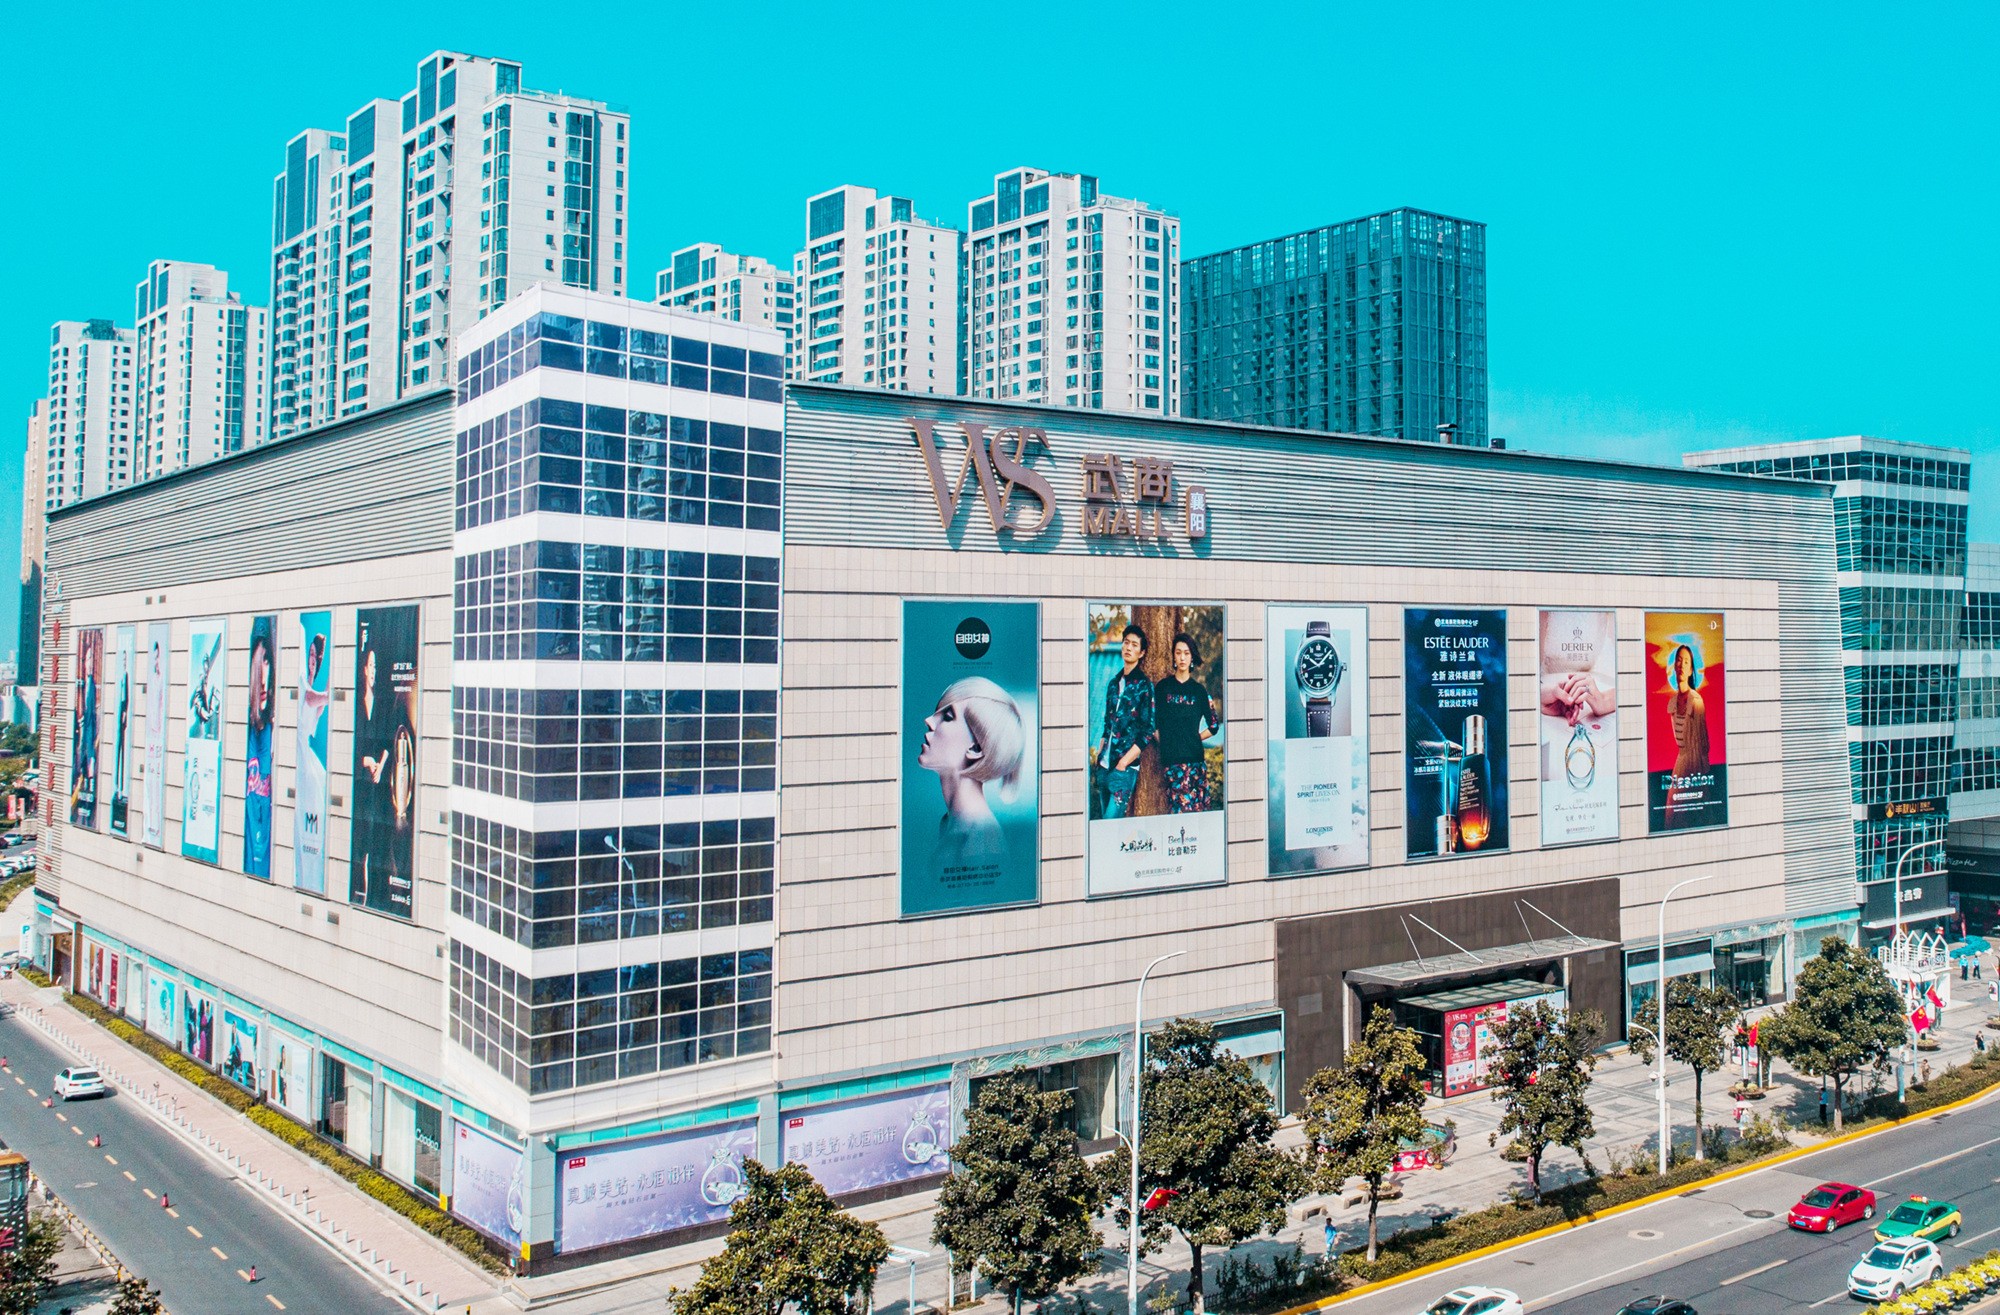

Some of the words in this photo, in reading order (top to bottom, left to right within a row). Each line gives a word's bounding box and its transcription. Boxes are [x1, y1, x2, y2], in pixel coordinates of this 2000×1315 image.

[905, 417, 1056, 532] WS
[1082, 453, 1174, 503] 武商
[1190, 491, 1205, 532] 襄阳
[1081, 505, 1173, 538] MALL
[955, 632, 990, 644] 自由女神
[1453, 637, 1489, 649] LAUDER
[1561, 643, 1593, 651] DERIER
[1440, 651, 1475, 662] 雅诗兰黛
[1306, 826, 1333, 834] LONGINES
[1168, 845, 1197, 856] 比音勒芬
[1963, 858, 1979, 867] Hut
[22, 925, 31, 934] P
